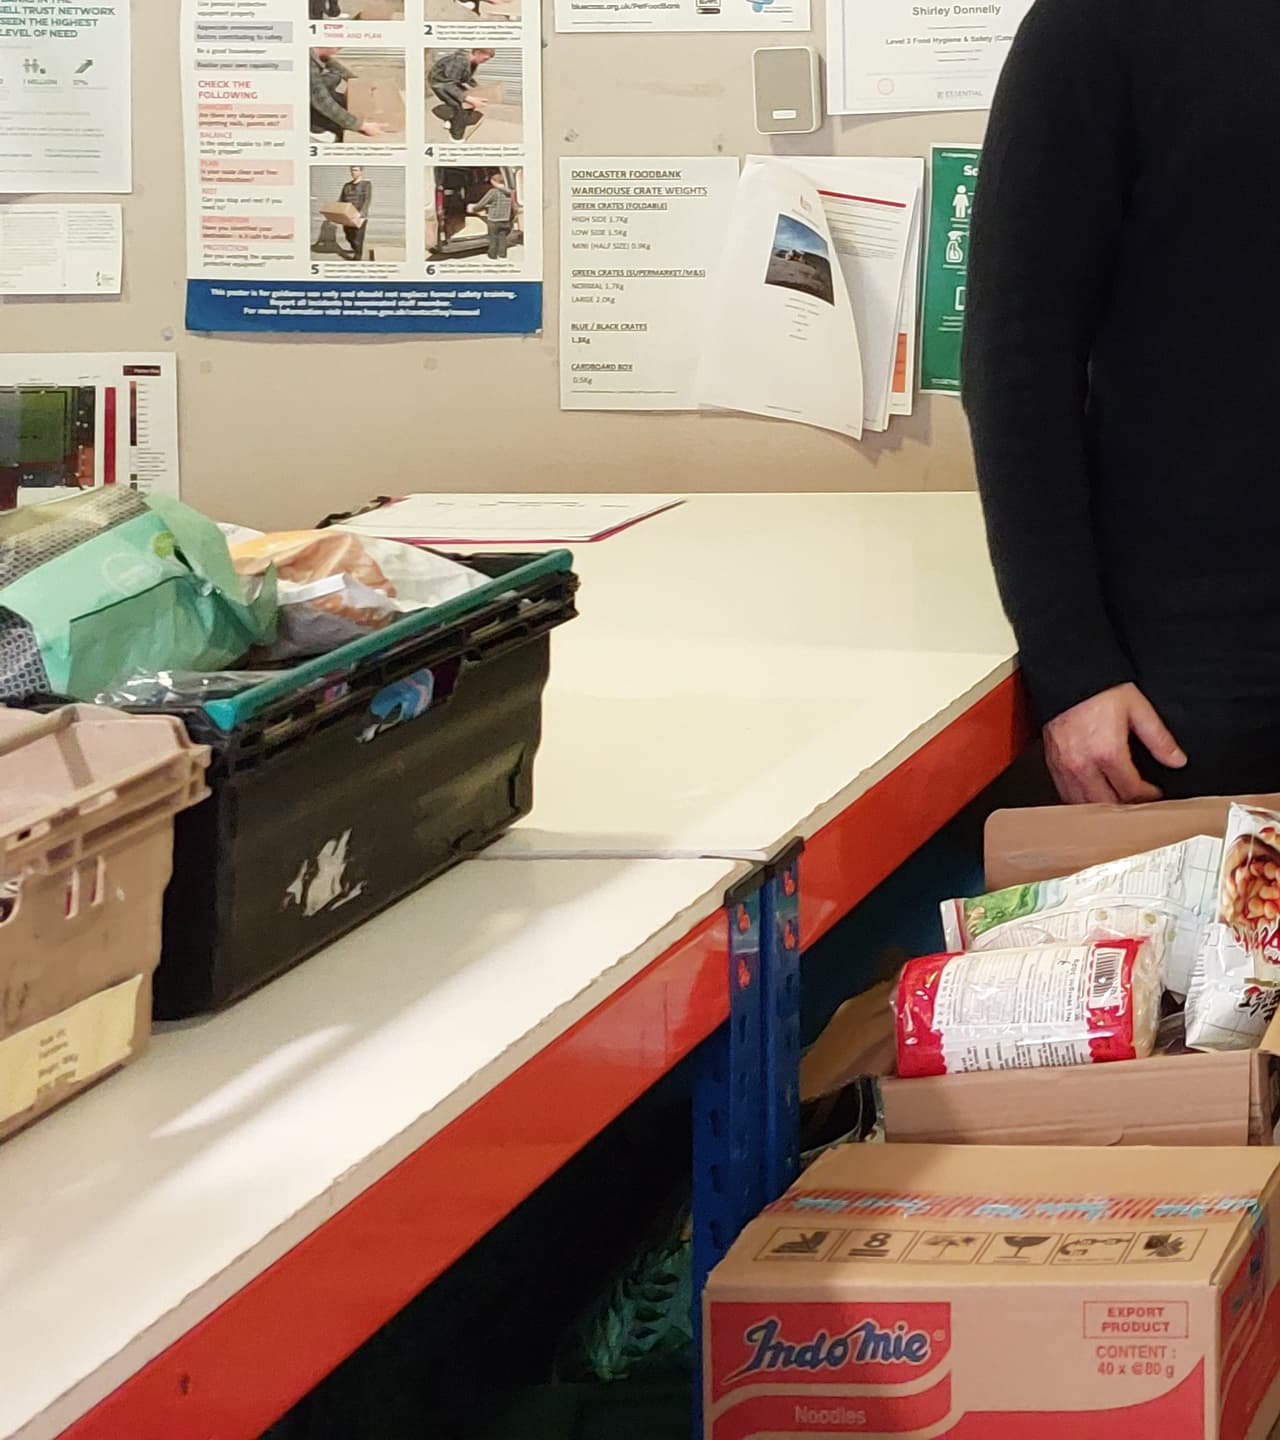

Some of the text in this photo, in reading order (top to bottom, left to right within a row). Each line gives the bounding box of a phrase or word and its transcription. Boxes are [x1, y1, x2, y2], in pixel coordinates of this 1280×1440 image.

[23, 7, 116, 16] TRUST NETWORK
[912, 4, 1001, 17] Shirley Donnelly
[29, 18, 99, 27] THE HIGHEST
[50, 30, 78, 38] NEED
[198, 91, 258, 99] FOLLOWING
[571, 171, 682, 179] DONCASTER FOODBANK
[571, 187, 708, 195] WAREHOUSE CRATE WEIGHTS
[1107, 1307, 1164, 1317] EXPORT
[1101, 1322, 1170, 1332] PRODUCT
[1096, 1345, 1167, 1358] CONTENT
[1098, 1362, 1114, 1375] 40
[1118, 1365, 1126, 1375] x
[1166, 1365, 1174, 1378] g
[795, 1406, 866, 1424] Noodles
